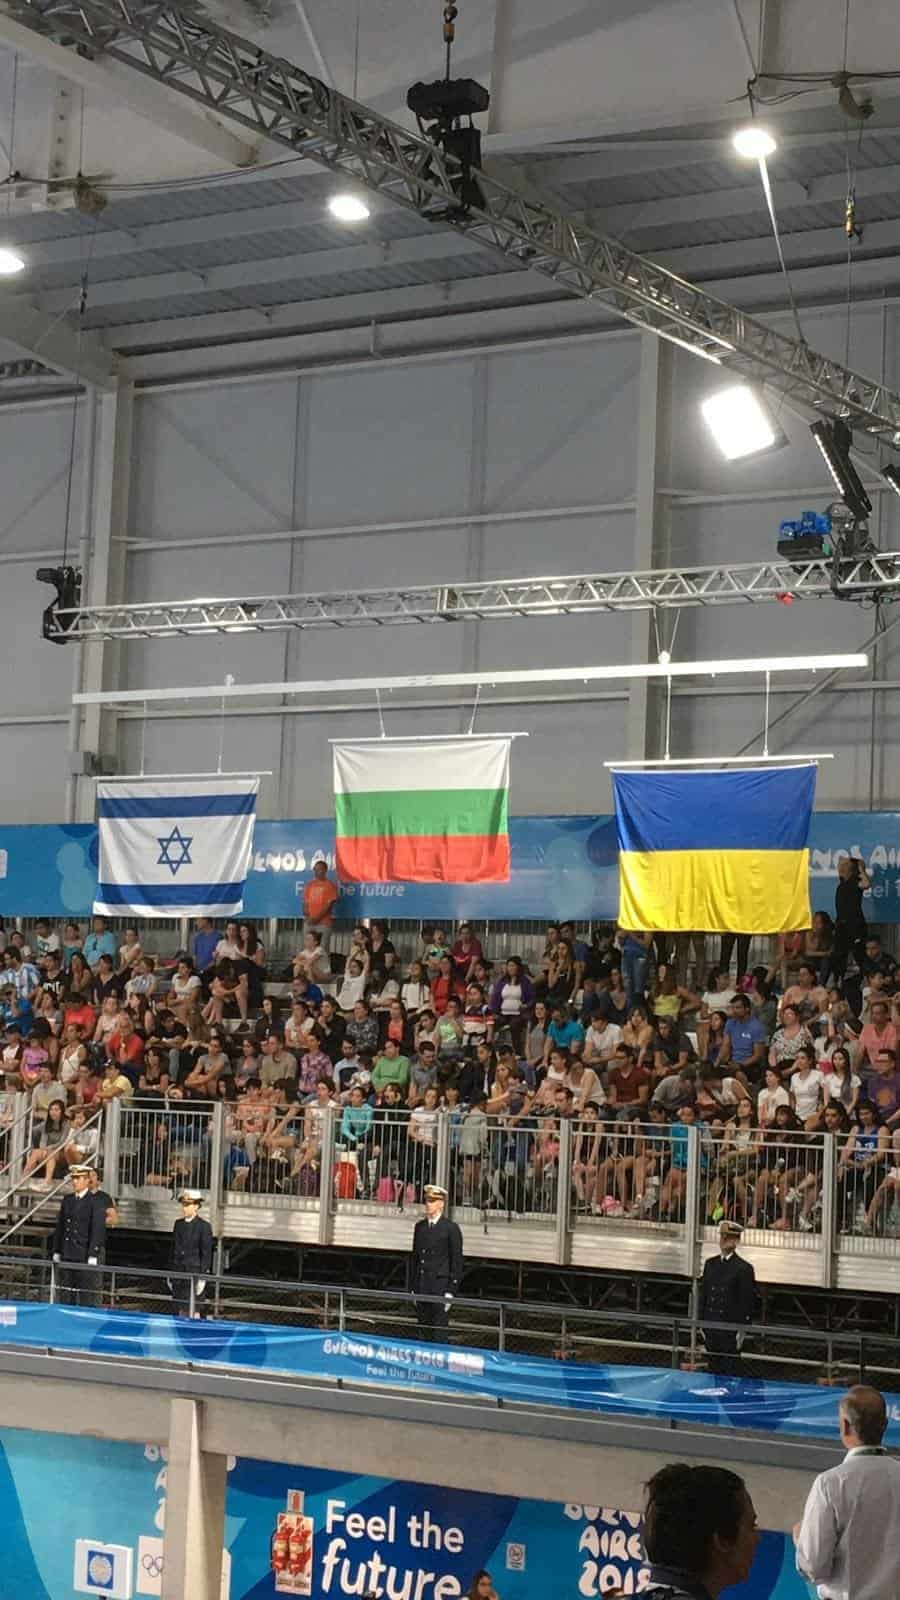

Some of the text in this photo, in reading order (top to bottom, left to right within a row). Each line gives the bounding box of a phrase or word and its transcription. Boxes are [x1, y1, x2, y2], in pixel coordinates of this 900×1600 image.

[360, 882, 405, 897] future
[863, 880, 889, 898] eel
[325, 1498, 465, 1554] Feel the
[578, 1525, 646, 1561] AIRE
[321, 1537, 462, 1600] future
